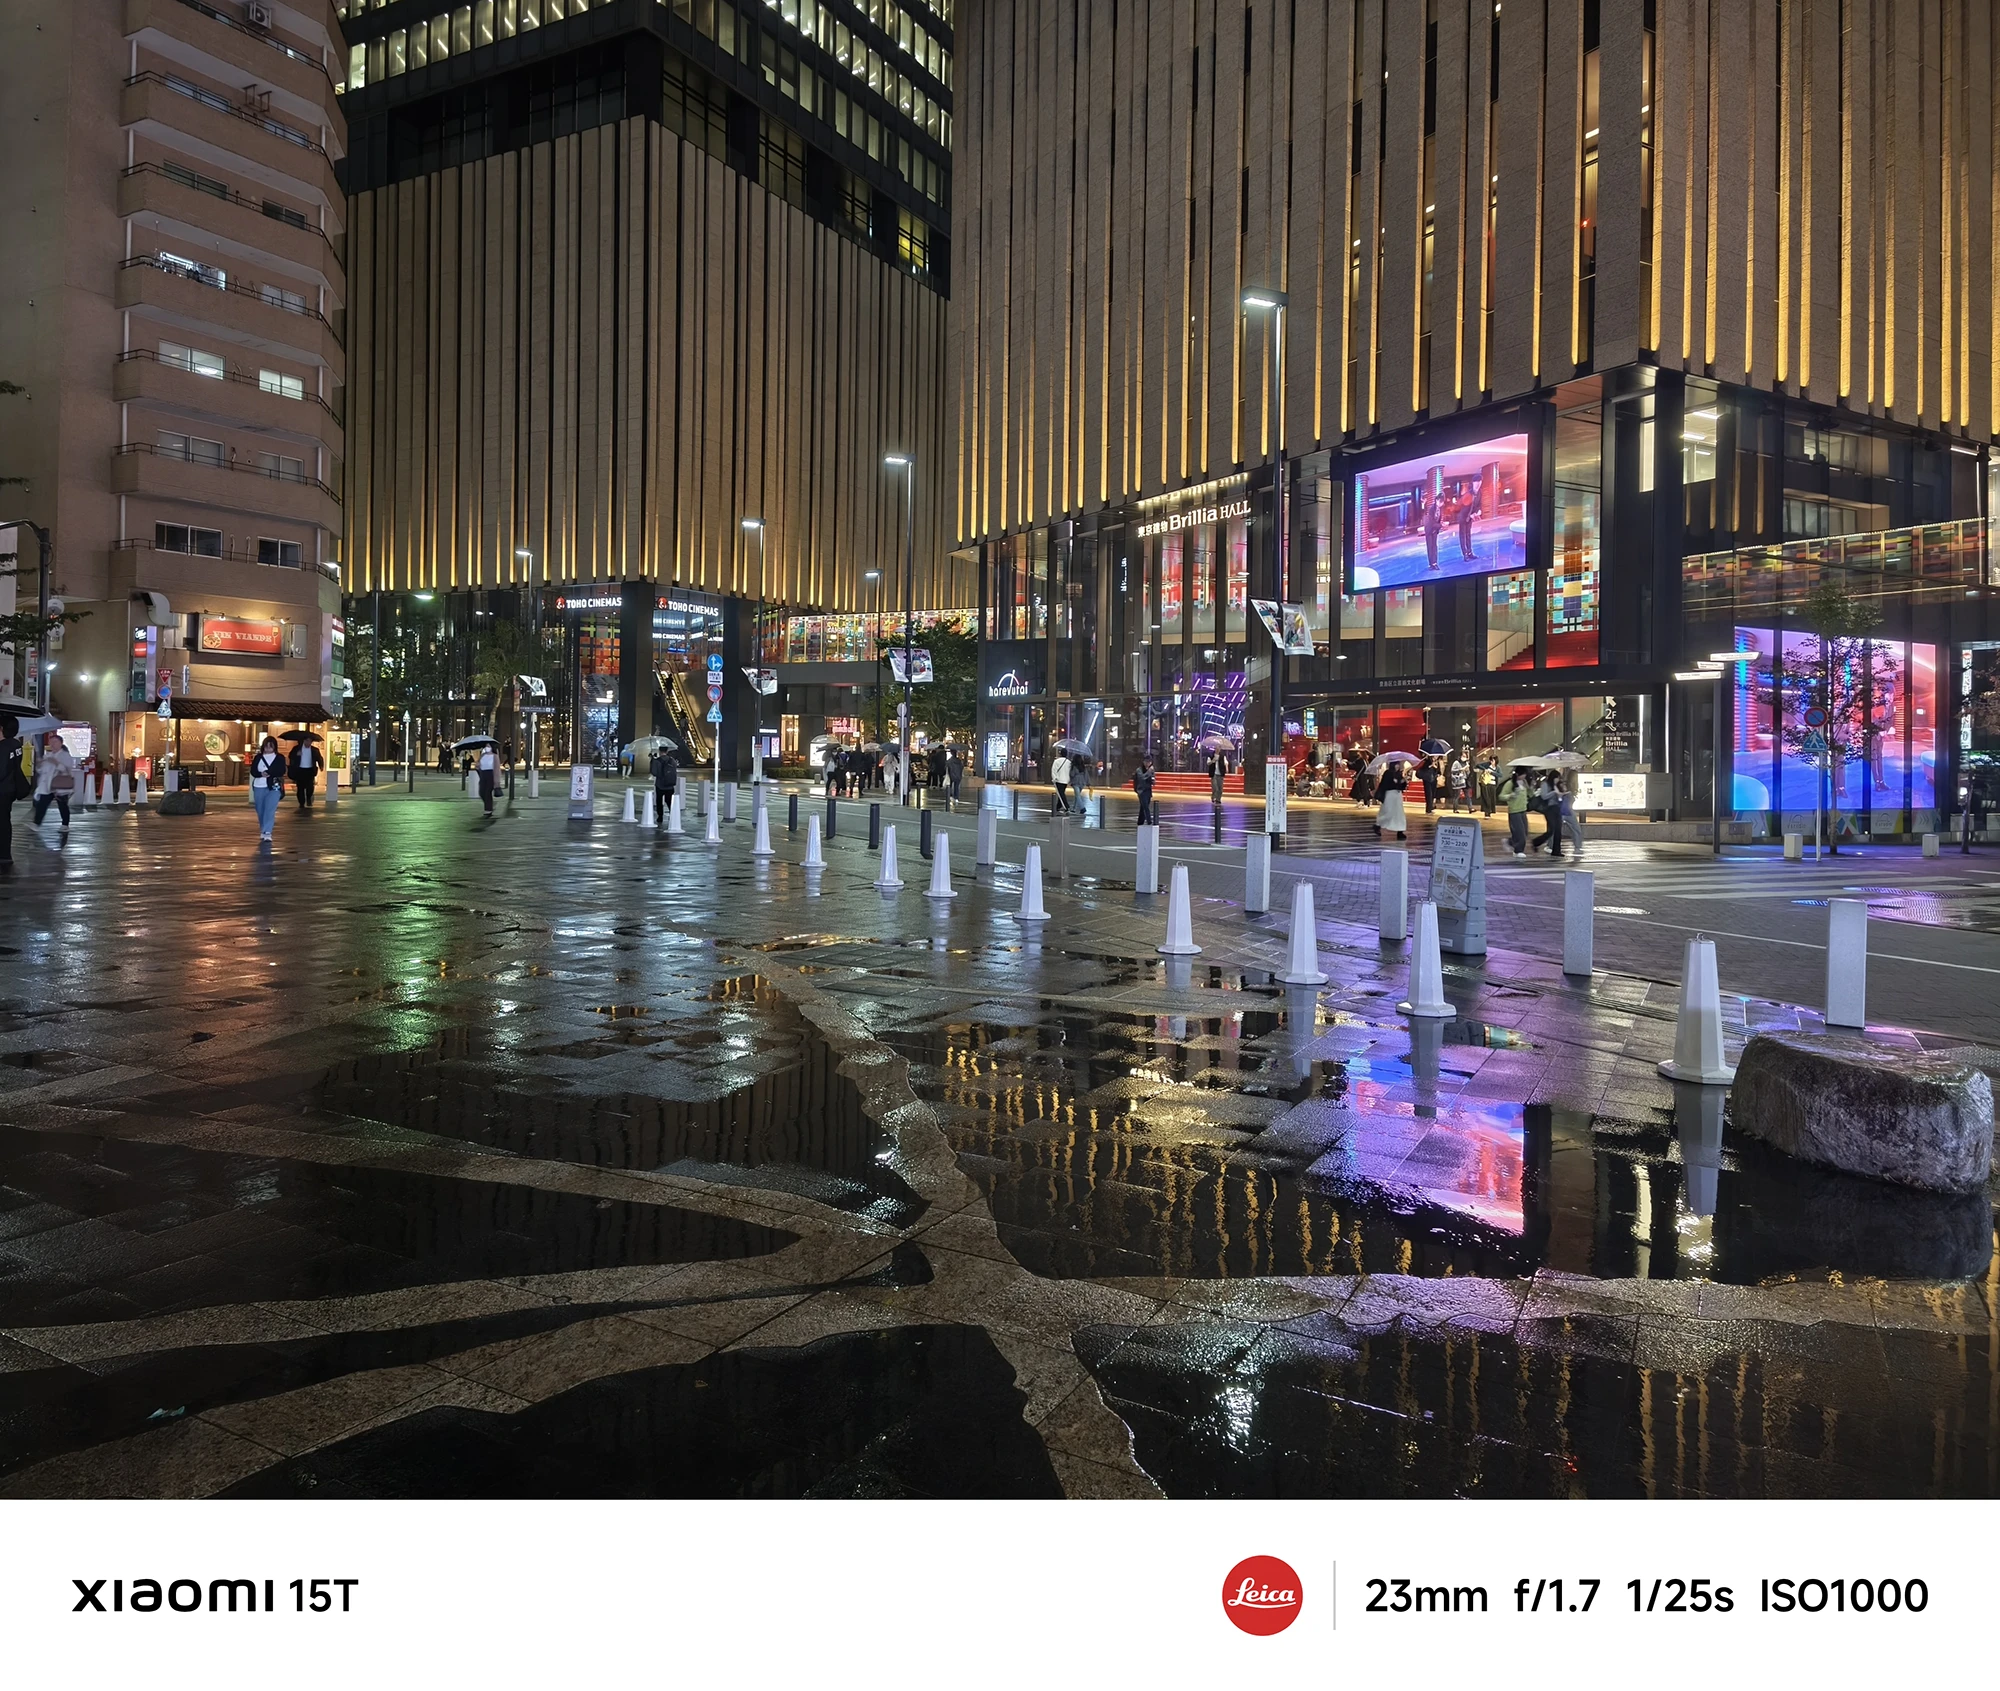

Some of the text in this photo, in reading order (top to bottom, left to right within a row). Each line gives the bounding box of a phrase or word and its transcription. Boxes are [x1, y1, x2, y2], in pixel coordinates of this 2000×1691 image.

[1138, 500, 1251, 538] 東京建物 Brillia HALL
[566, 597, 622, 609] TOHO CINEMAS
[668, 601, 719, 616] TOHO CINEMAS
[235, 632, 272, 642] VIANDE
[1605, 708, 1617, 719] 2F
